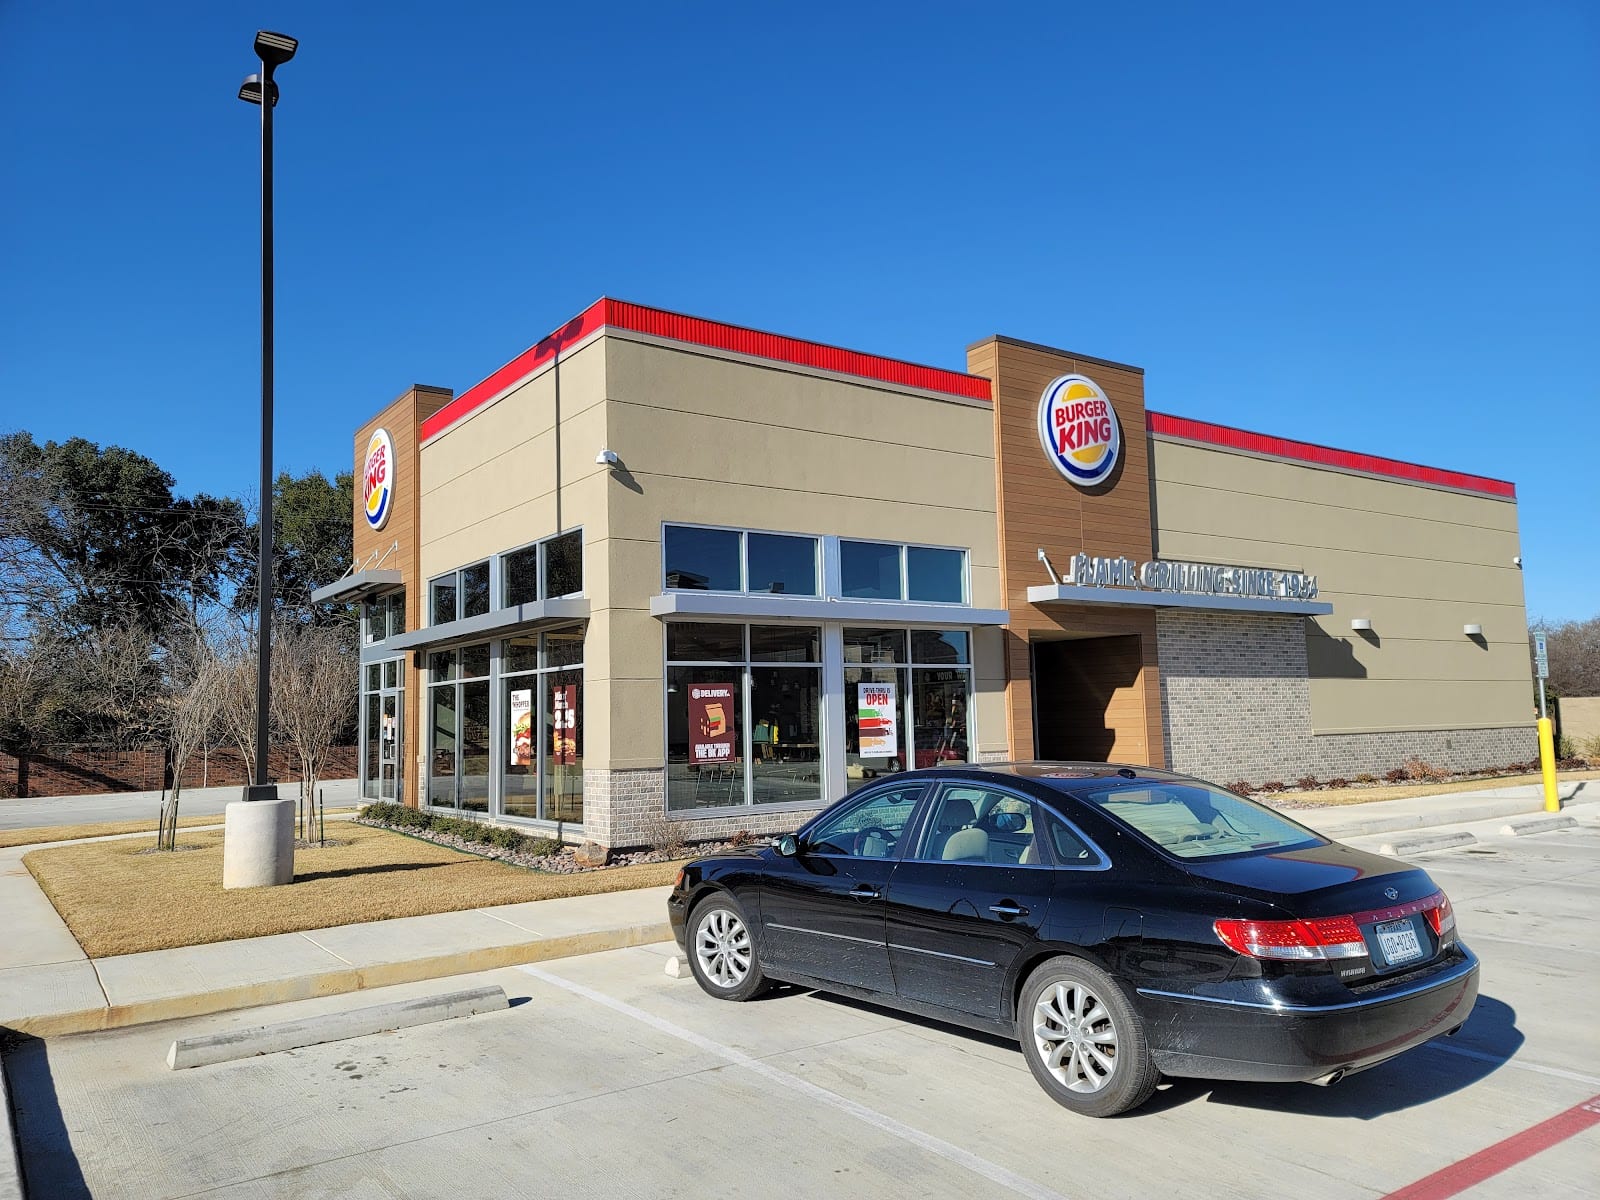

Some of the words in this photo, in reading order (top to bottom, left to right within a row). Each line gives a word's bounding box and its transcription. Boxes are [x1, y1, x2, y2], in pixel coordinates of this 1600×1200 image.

[1056, 401, 1108, 428] BURGER
[1059, 418, 1111, 454] KING
[1072, 553, 1137, 586] FLAME
[1141, 561, 1225, 593] GRILLING
[1231, 568, 1275, 596] SINCE
[1279, 573, 1319, 599] 1954
[936, 671, 952, 681] YOUR
[700, 689, 728, 698] DELIVERY
[866, 694, 888, 705] OPEN
[695, 749, 707, 759] THE
[707, 748, 717, 758] BK
[717, 747, 730, 757] APP
